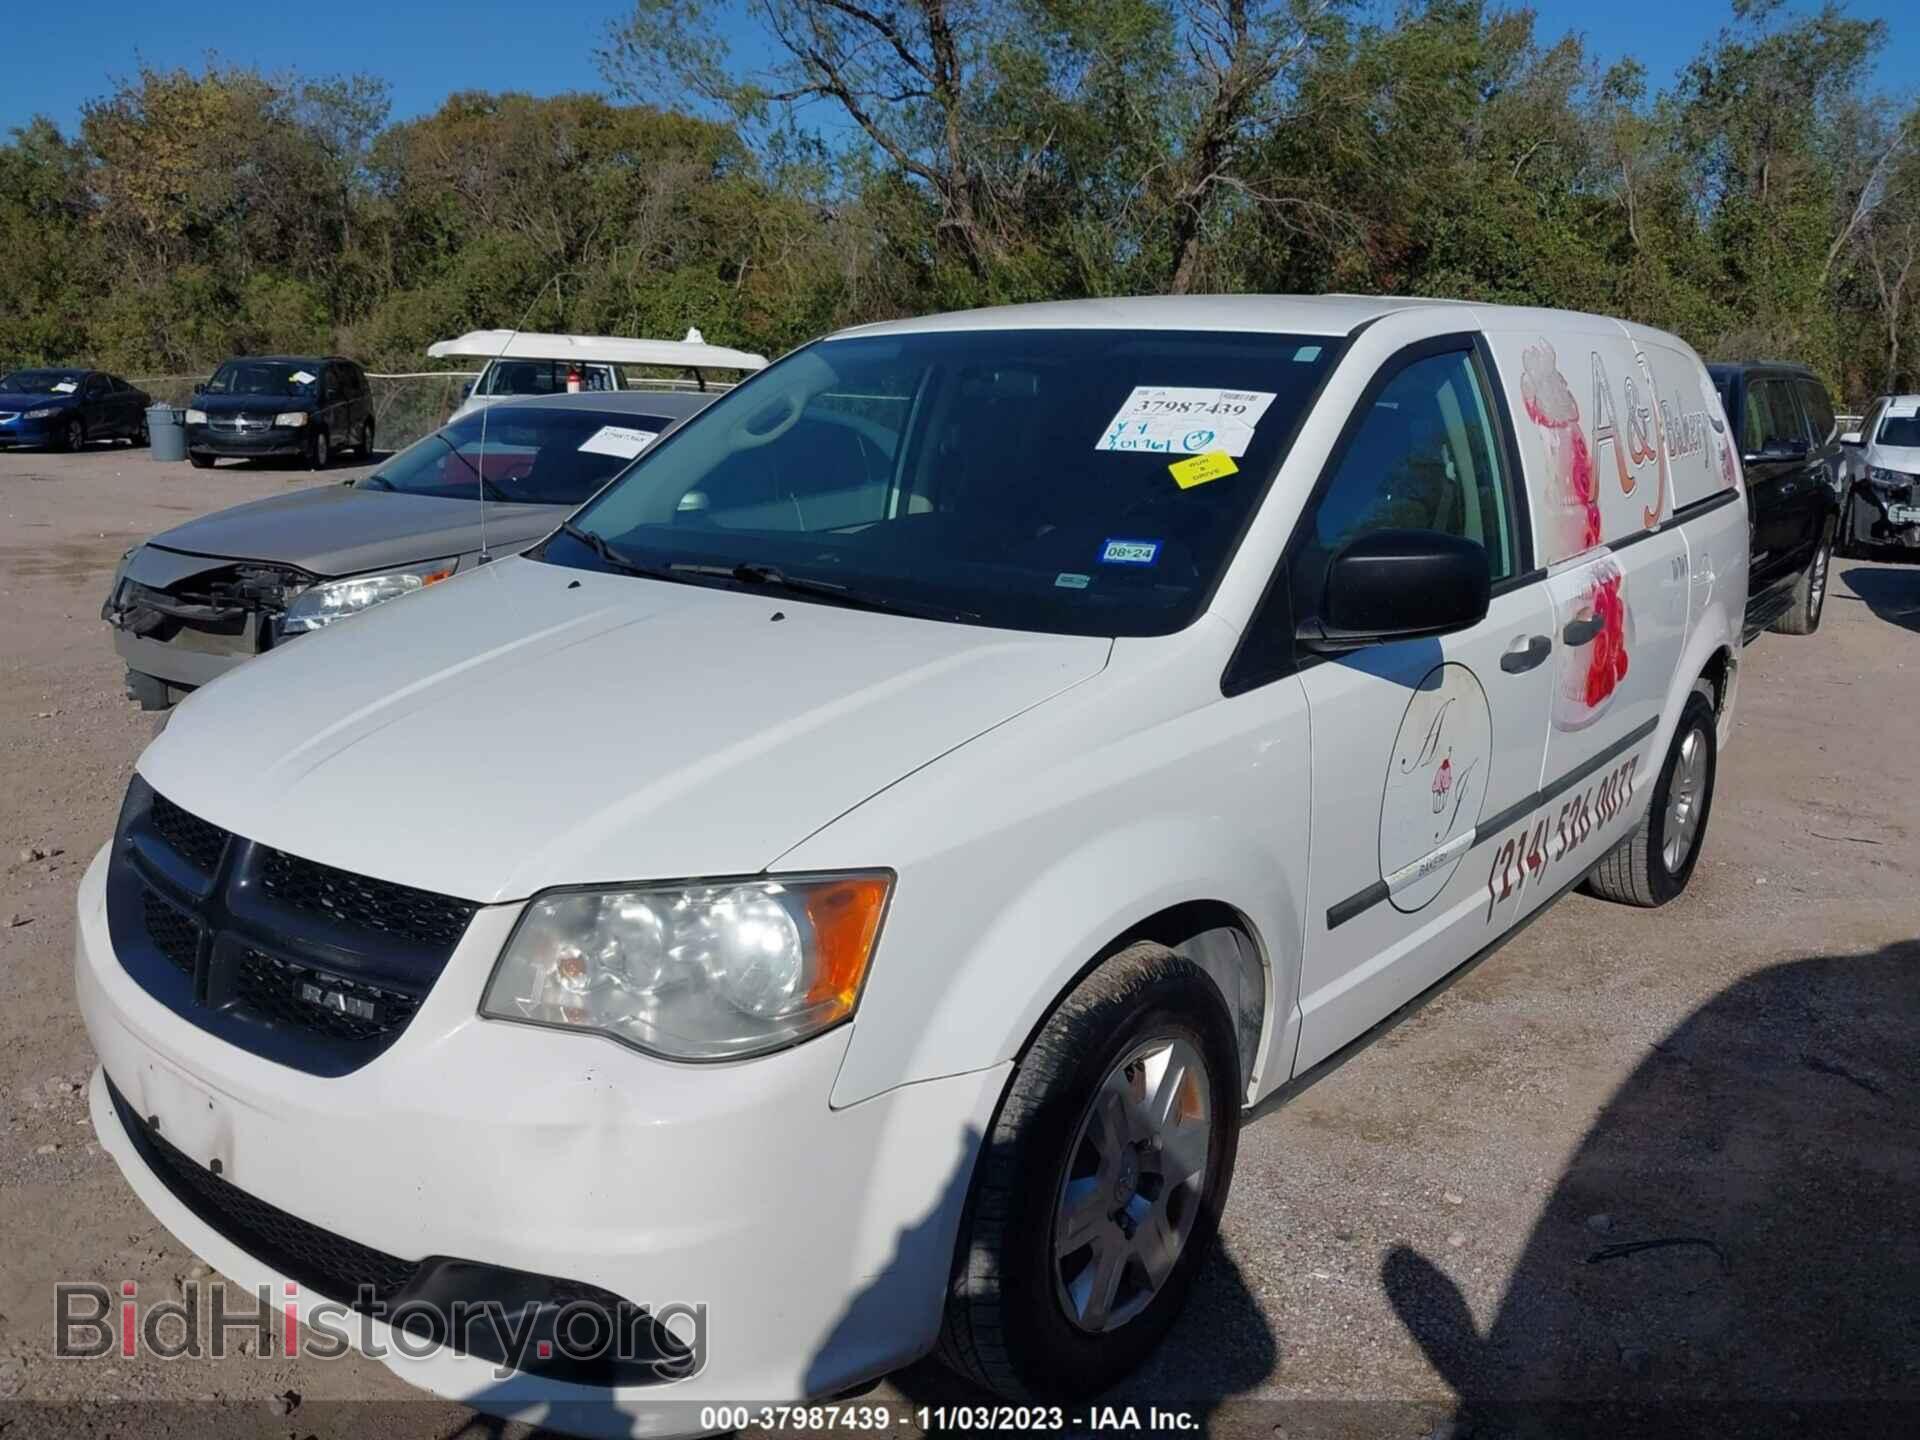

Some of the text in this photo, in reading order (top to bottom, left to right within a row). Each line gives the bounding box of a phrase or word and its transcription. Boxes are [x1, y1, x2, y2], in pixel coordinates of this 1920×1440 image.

[1133, 400, 1247, 415] 37987439
[1486, 753, 1640, 925] (214) 526 0077
